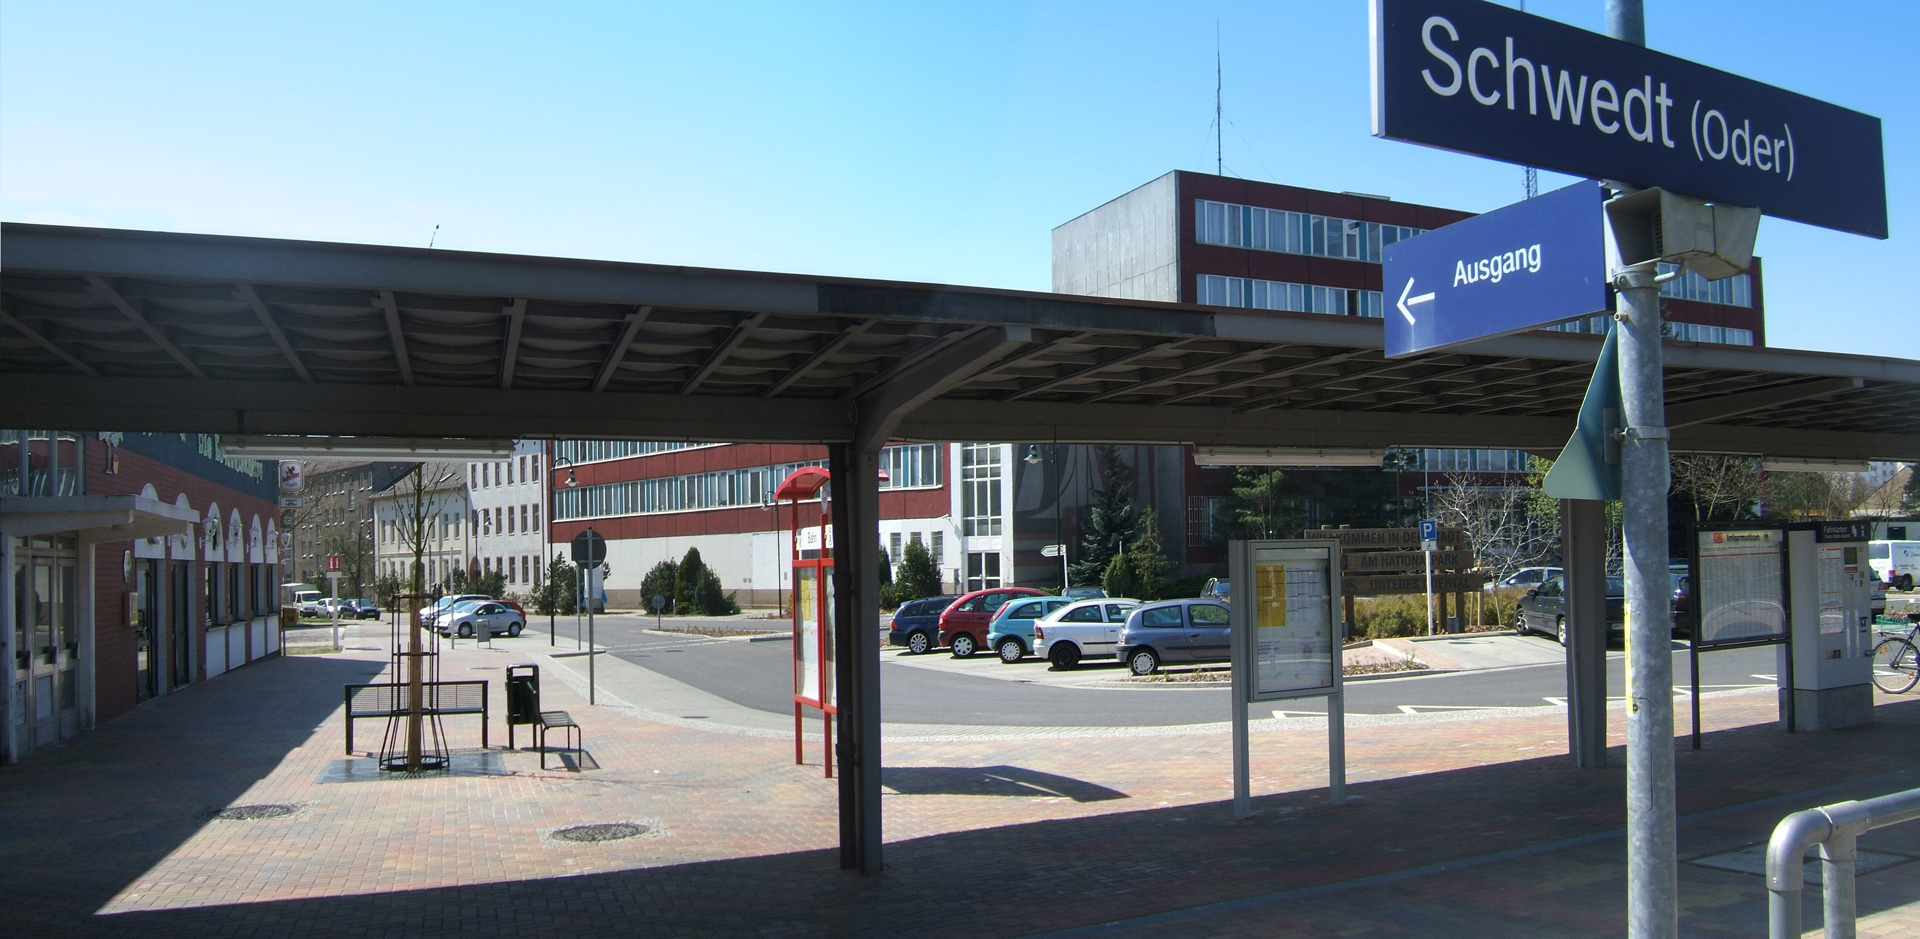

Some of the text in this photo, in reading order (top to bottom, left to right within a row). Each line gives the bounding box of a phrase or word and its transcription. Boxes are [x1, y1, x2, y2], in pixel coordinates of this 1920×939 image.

[1420, 15, 1795, 182] Schwedt (Oder)
[1453, 243, 1541, 288] Ausgang
[1423, 522, 1433, 538] P
[807, 531, 818, 543] Bahn
[1388, 532, 1399, 544] IN
[1436, 531, 1461, 543] TADT
[1726, 533, 1760, 542] Information
[1361, 554, 1458, 567] AM NATIONAPARK
[1370, 578, 1419, 591] UNTERES
